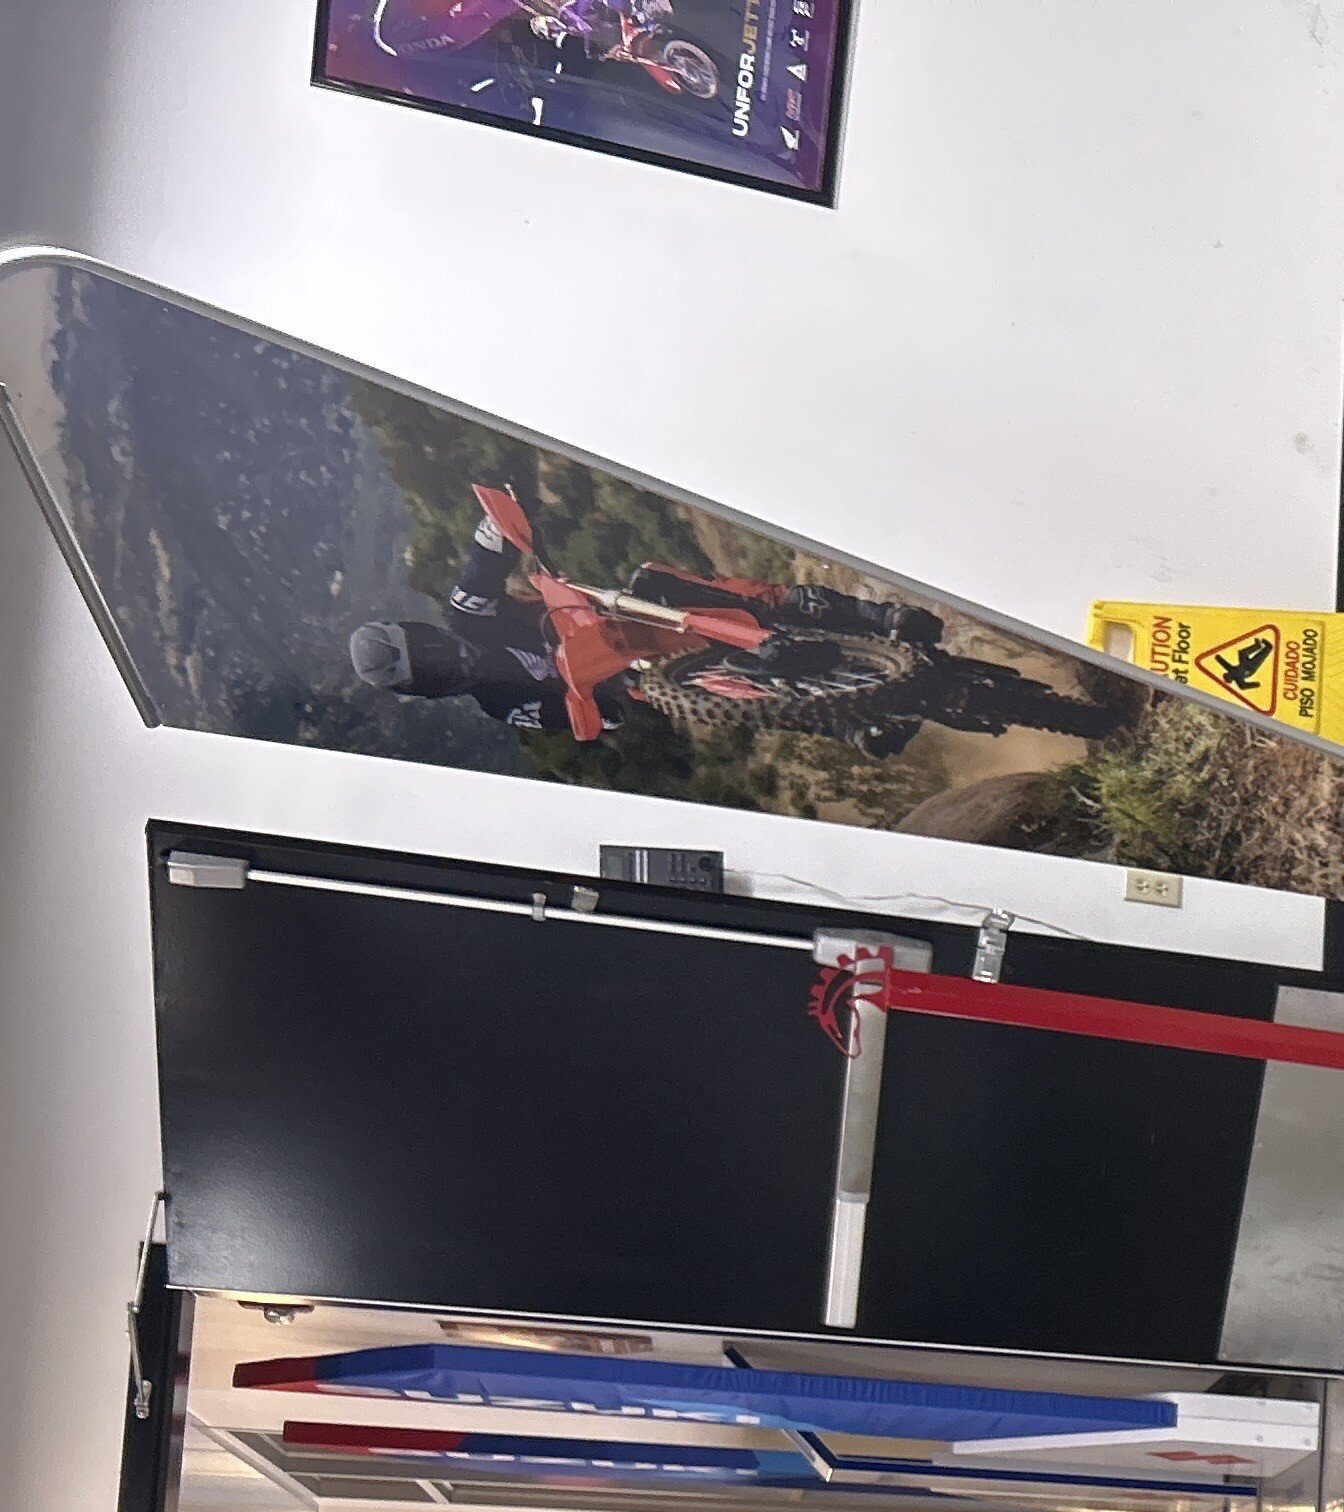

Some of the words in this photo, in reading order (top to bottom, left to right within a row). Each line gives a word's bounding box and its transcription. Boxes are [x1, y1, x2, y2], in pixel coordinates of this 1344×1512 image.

[1150, 616, 1172, 676] UTION
[1172, 622, 1191, 664] Floor
[1301, 628, 1318, 682] MOJADO
[1172, 668, 1189, 684] et
[1282, 640, 1300, 700] CUIDADO
[1299, 688, 1314, 718] PISO
